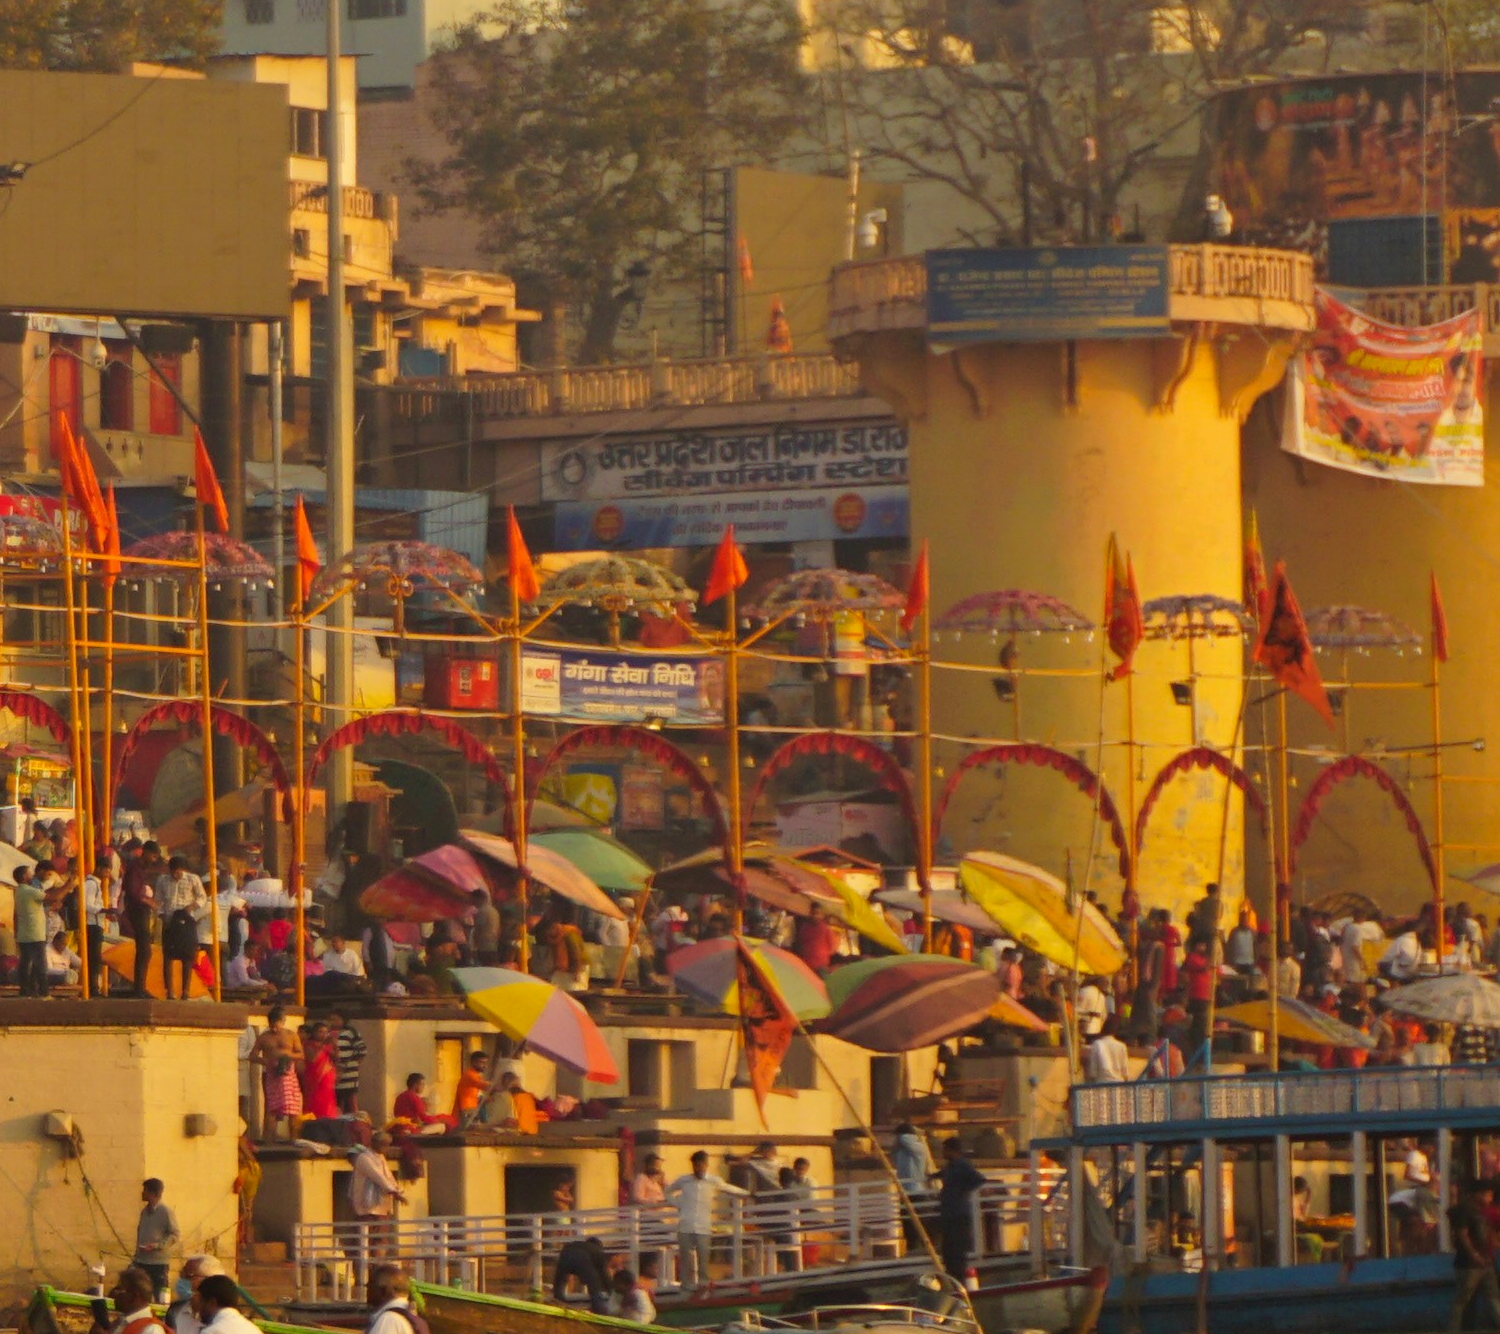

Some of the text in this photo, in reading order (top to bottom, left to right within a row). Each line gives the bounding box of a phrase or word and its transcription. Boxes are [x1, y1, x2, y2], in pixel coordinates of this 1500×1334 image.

[563, 658, 608, 684] गंगा
[610, 661, 648, 685] सेवा
[652, 662, 696, 687] निधि
